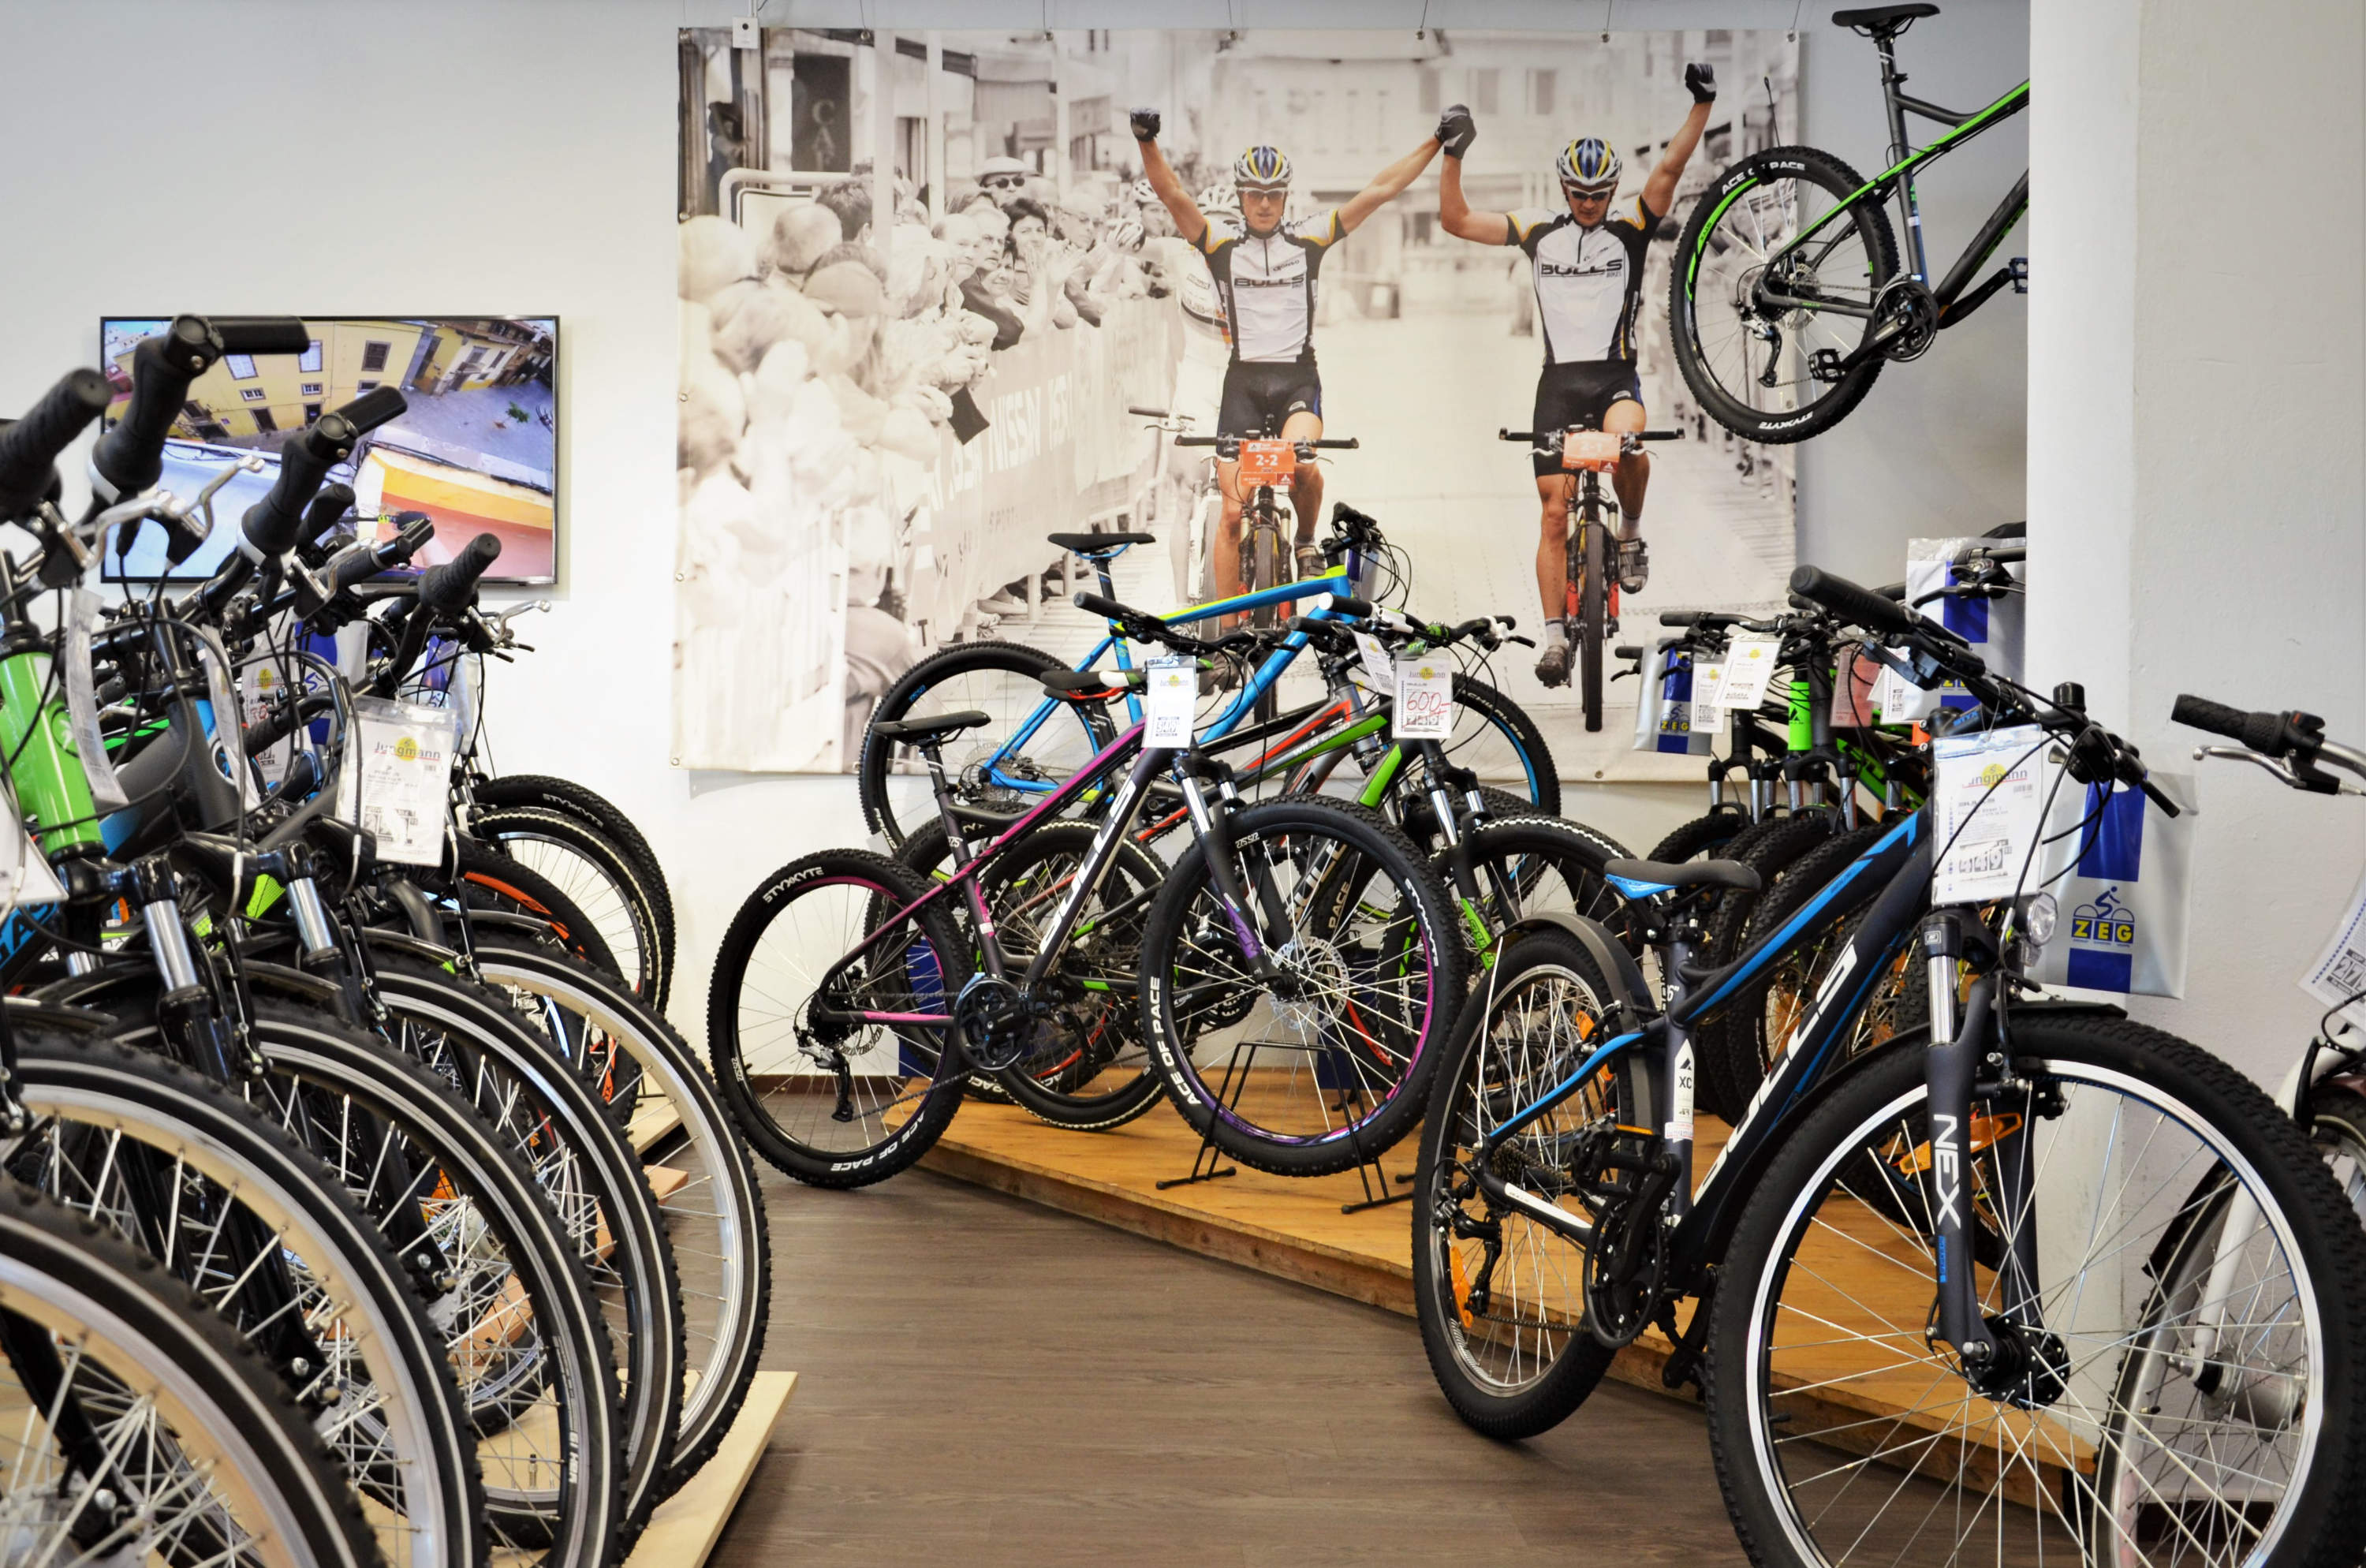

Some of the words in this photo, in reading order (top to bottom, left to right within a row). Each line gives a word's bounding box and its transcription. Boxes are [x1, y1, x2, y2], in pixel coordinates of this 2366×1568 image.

[1722, 171, 1746, 196] ACE
[1769, 161, 1806, 171] PACE
[1541, 259, 1623, 276] BULLS
[1234, 276, 1304, 289] BULLS
[1256, 454, 1279, 467] 2-2
[1660, 720, 1690, 731] ZEG
[1039, 774, 1137, 956] BULLS
[1327, 880, 1350, 929] PACE
[2073, 920, 2133, 943] ZEG
[1149, 976, 1164, 1034] PACE
[1157, 1041, 1175, 1068] OF
[1679, 1075, 1692, 1088] XC
[1692, 935, 1858, 1207] BULLS
[1170, 1071, 1202, 1105] ACE
[901, 1111, 926, 1144] ACE
[830, 1156, 873, 1172] PACE
[879, 1141, 898, 1160] OF
[1934, 1114, 1961, 1230] NEX
